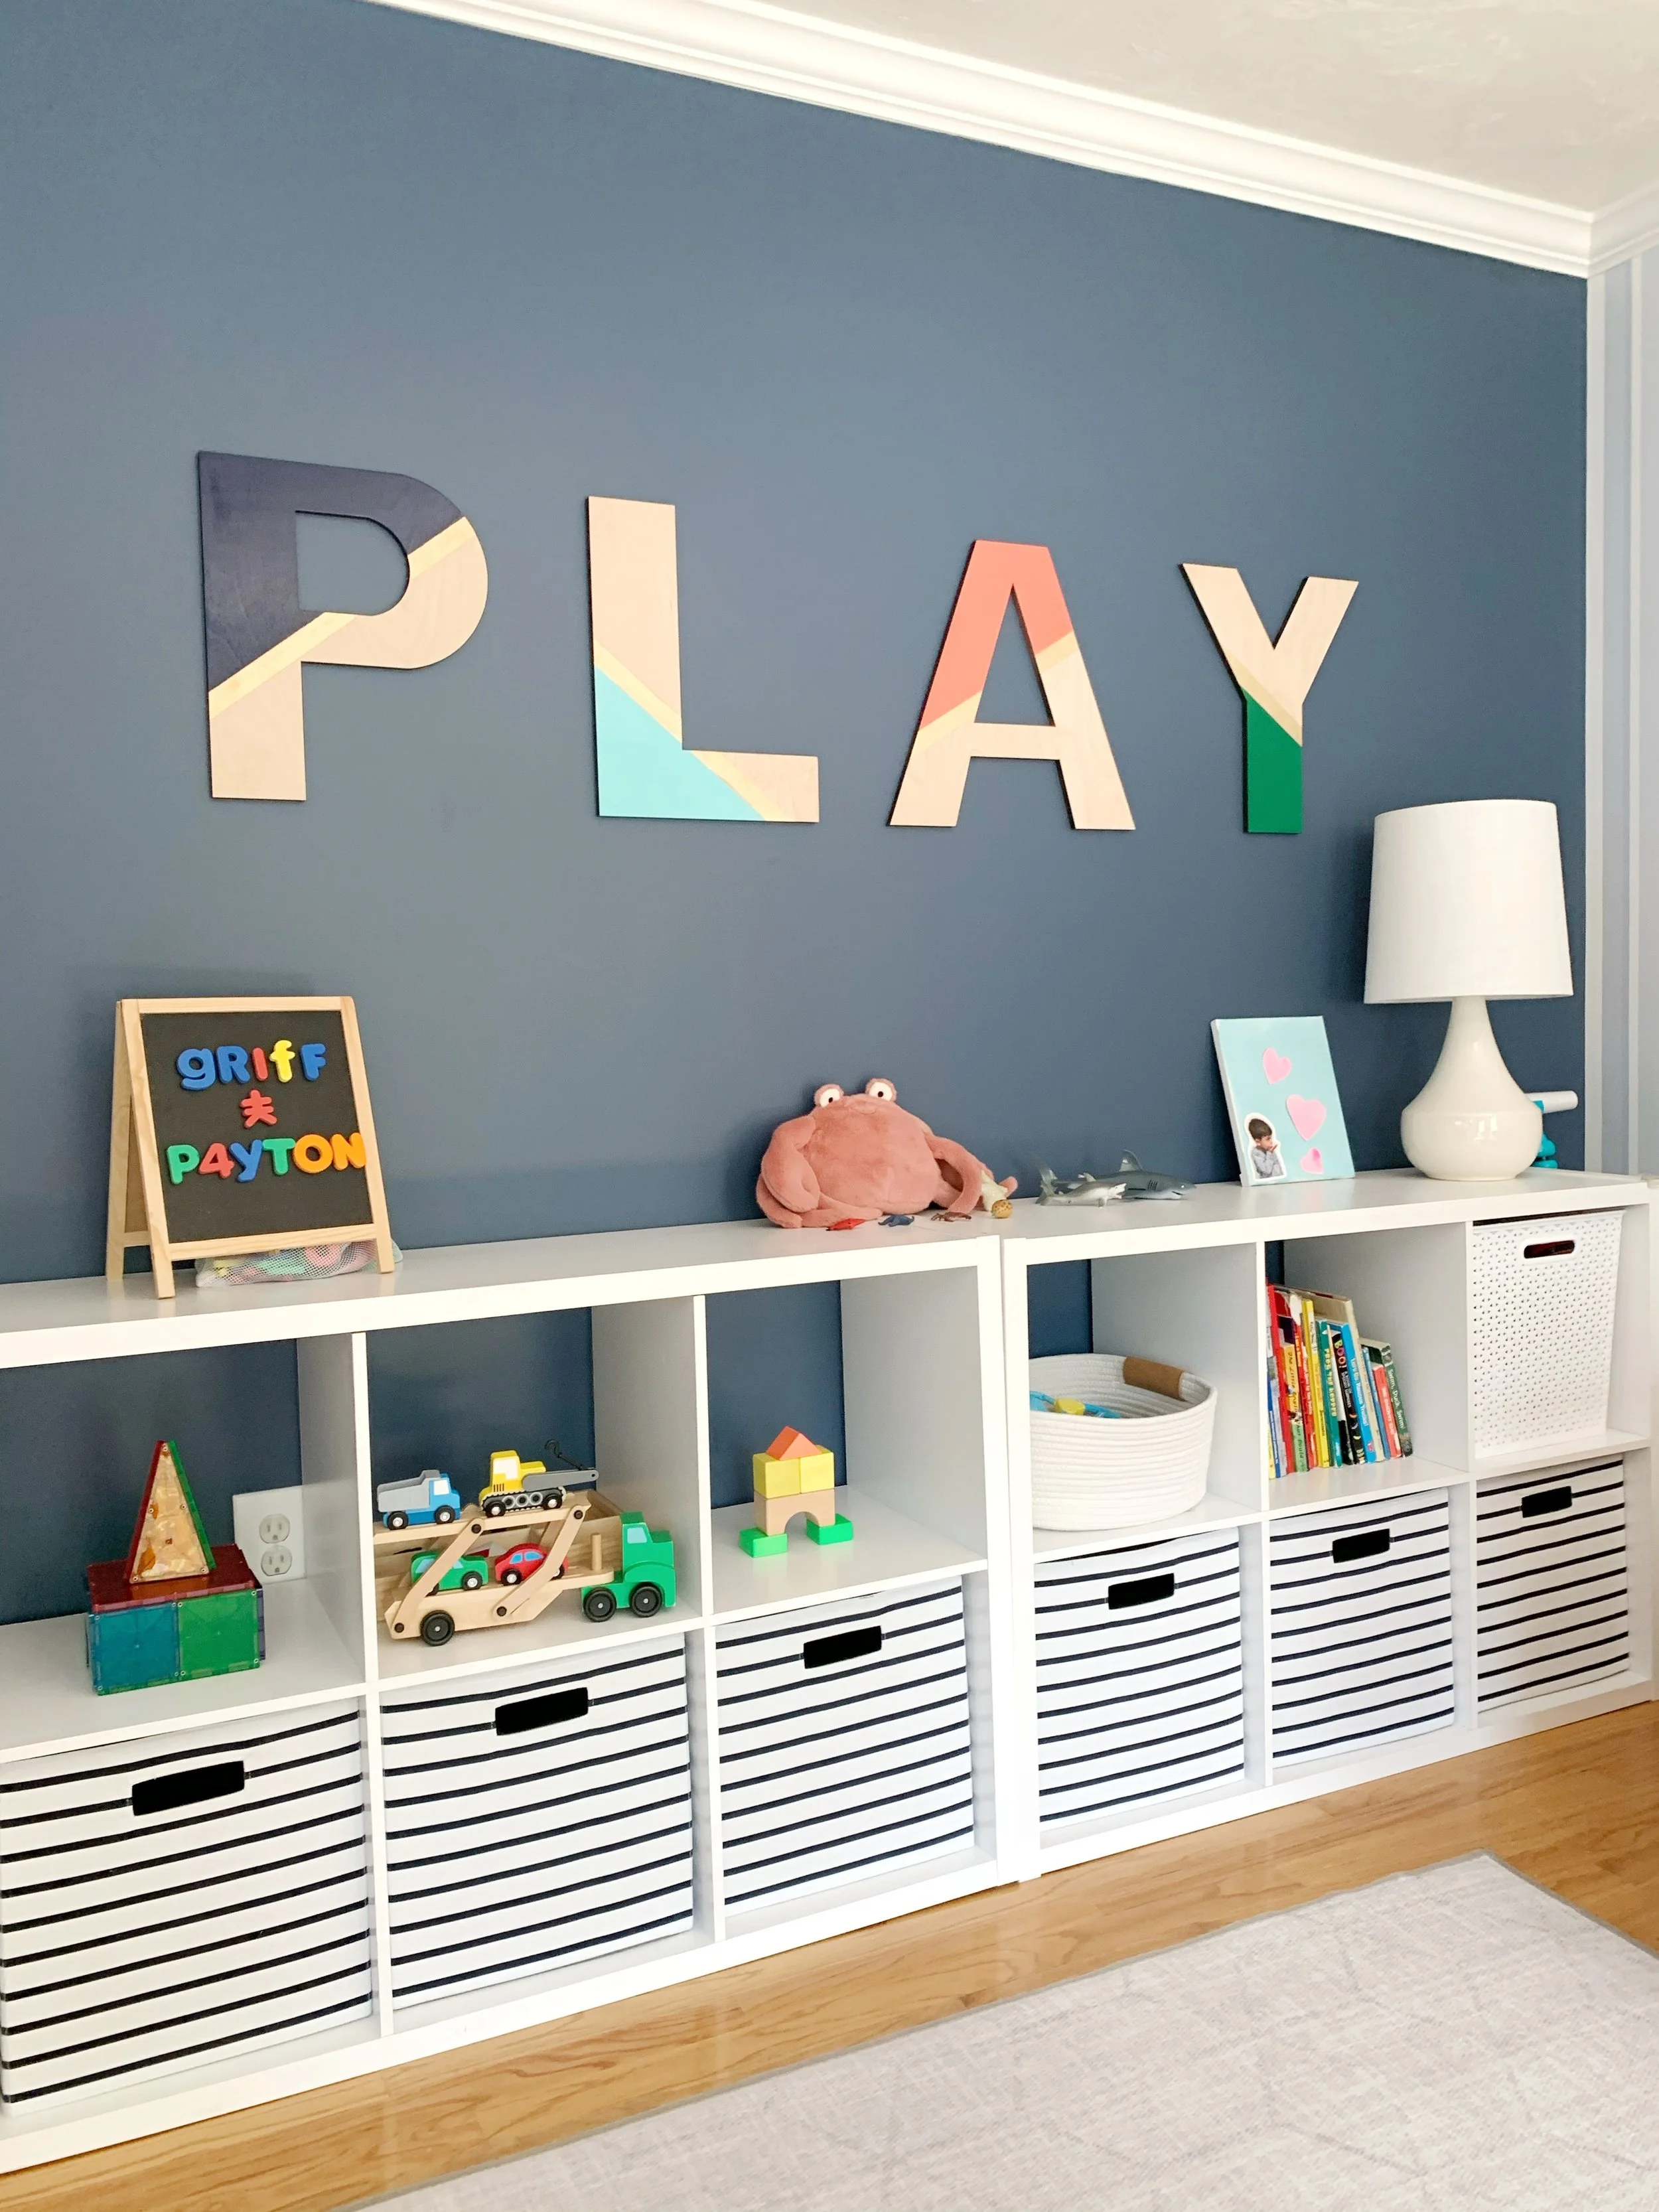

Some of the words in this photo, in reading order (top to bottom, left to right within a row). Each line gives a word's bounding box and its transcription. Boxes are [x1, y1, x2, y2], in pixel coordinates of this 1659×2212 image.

[196, 451, 1360, 835] PLAY
[1334, 1339, 1347, 1368] BOO!
[1397, 1410, 1406, 1429] Swim!
